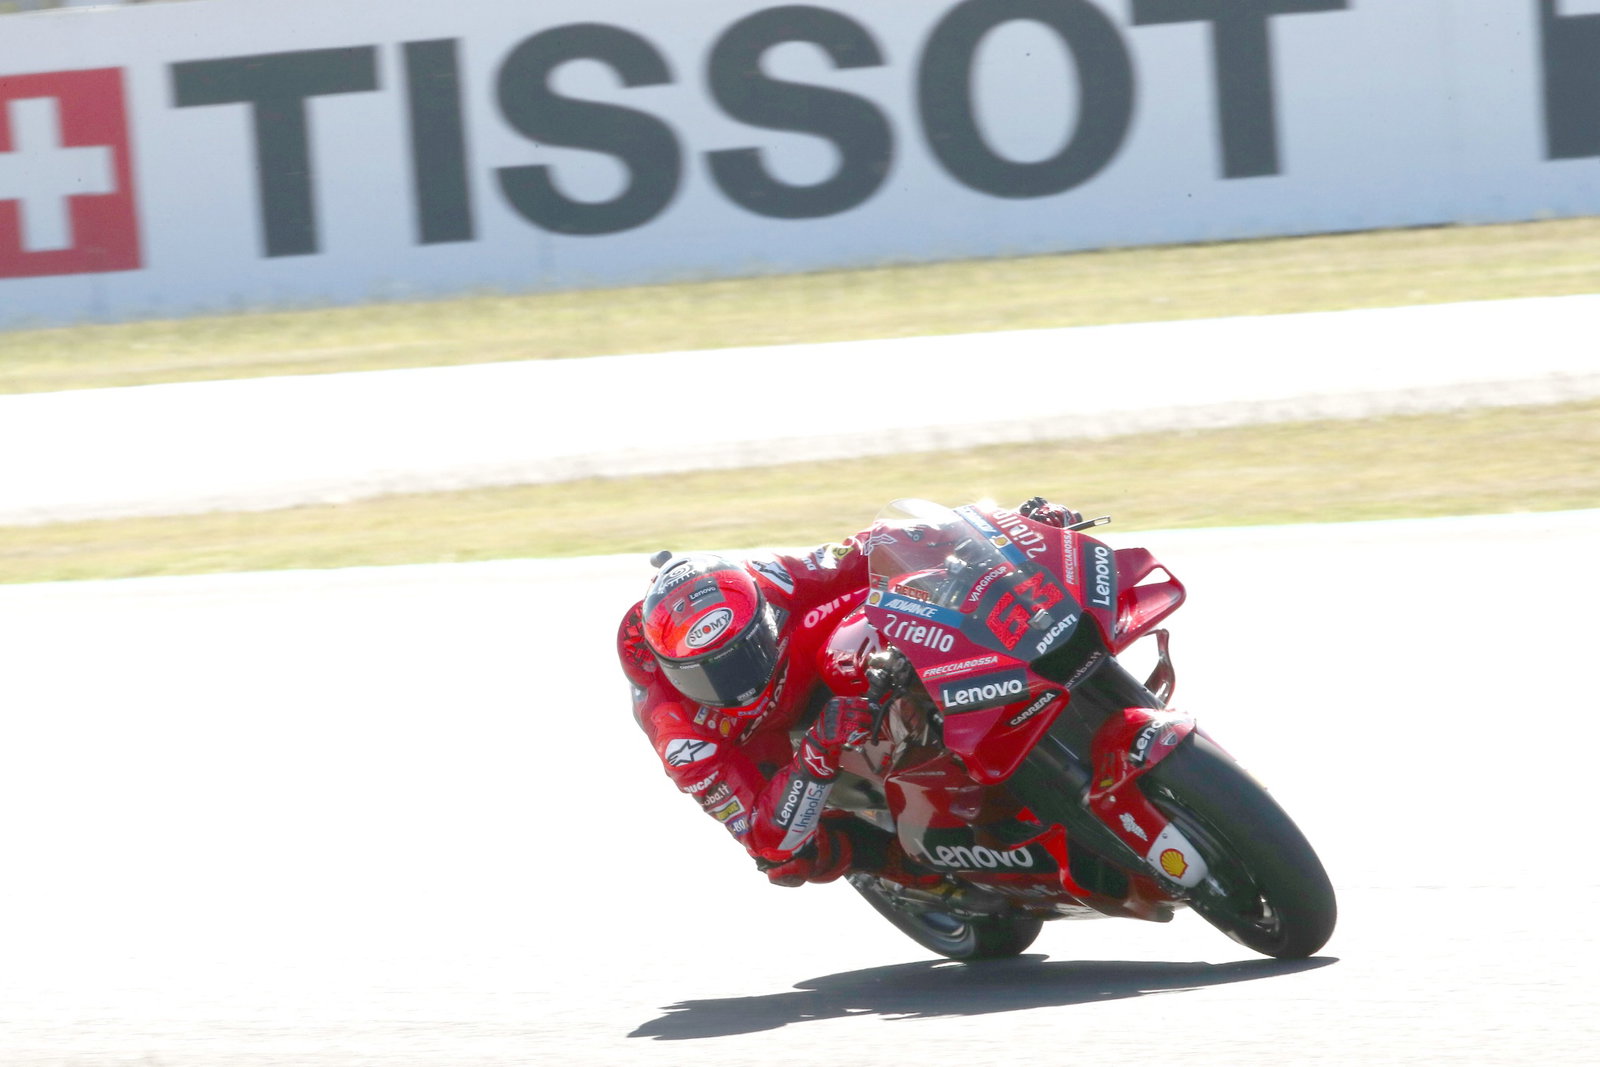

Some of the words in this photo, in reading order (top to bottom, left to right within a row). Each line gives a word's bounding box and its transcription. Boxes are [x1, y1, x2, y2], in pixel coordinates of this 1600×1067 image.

[166, 0, 1356, 259] TISSOT
[1093, 545, 1110, 606] Lenovo
[689, 585, 717, 600] Lenovo
[884, 598, 937, 618] ADVANCE
[688, 612, 731, 643] SUOMY
[985, 571, 1065, 651] 63
[1035, 613, 1077, 655] DUCATI
[922, 655, 999, 677] FRECCIAROSSA
[943, 679, 1023, 708] Lenovo
[1010, 692, 1056, 727] CARRERA
[777, 779, 804, 826] Lenovo
[915, 838, 1034, 868] Lenovo
